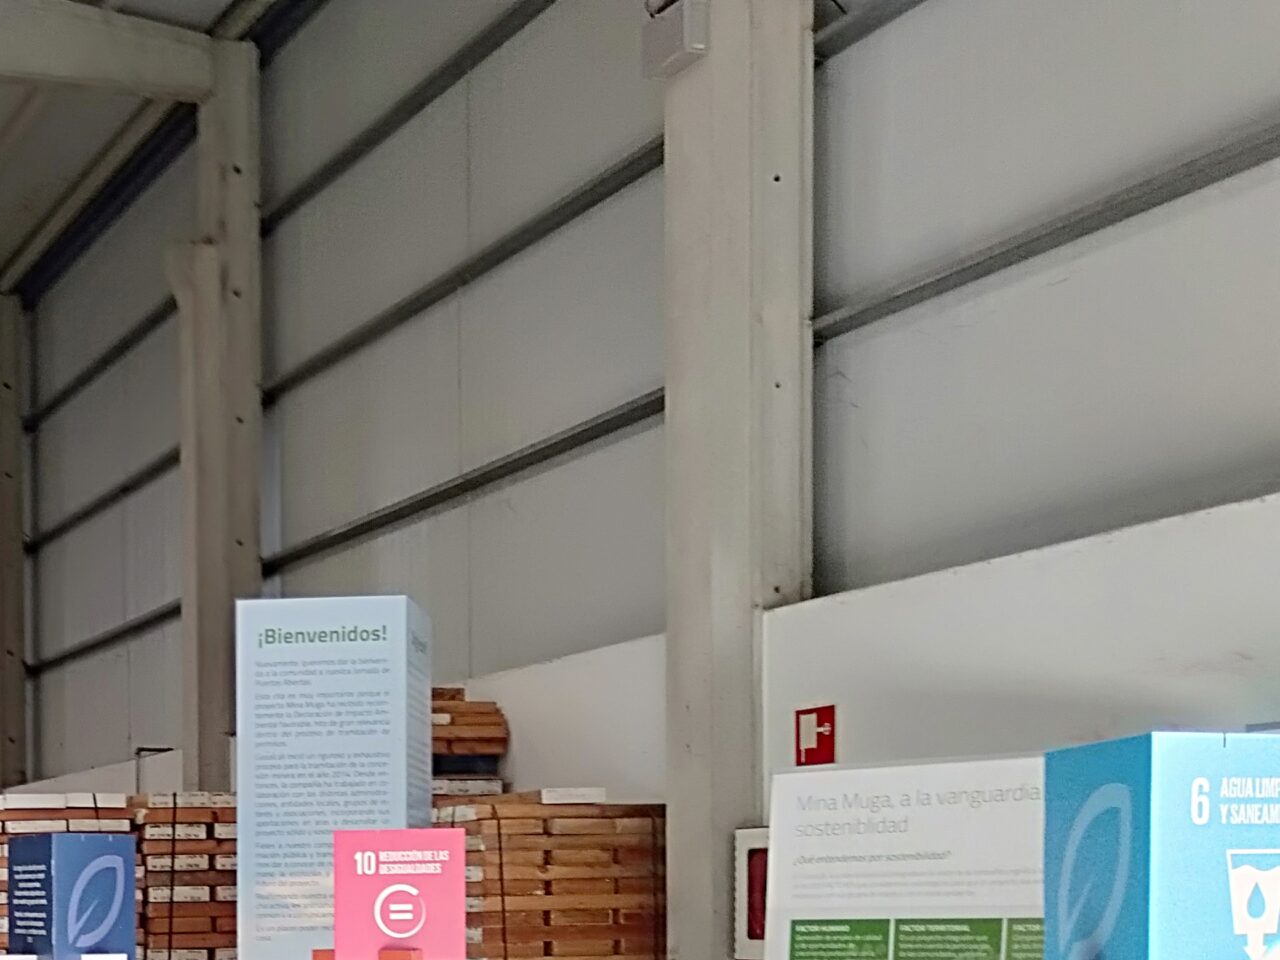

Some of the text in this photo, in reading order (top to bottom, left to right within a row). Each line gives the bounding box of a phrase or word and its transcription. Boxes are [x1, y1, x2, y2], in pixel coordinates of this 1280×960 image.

[258, 625, 388, 648] ¡Bienvenidos!
[796, 785, 1042, 813] Mina Muga, a la vanguardia
[1220, 777, 1254, 798] AGUA
[1190, 776, 1210, 826] 6
[1220, 803, 1229, 825] Y
[354, 851, 376, 875] 10
